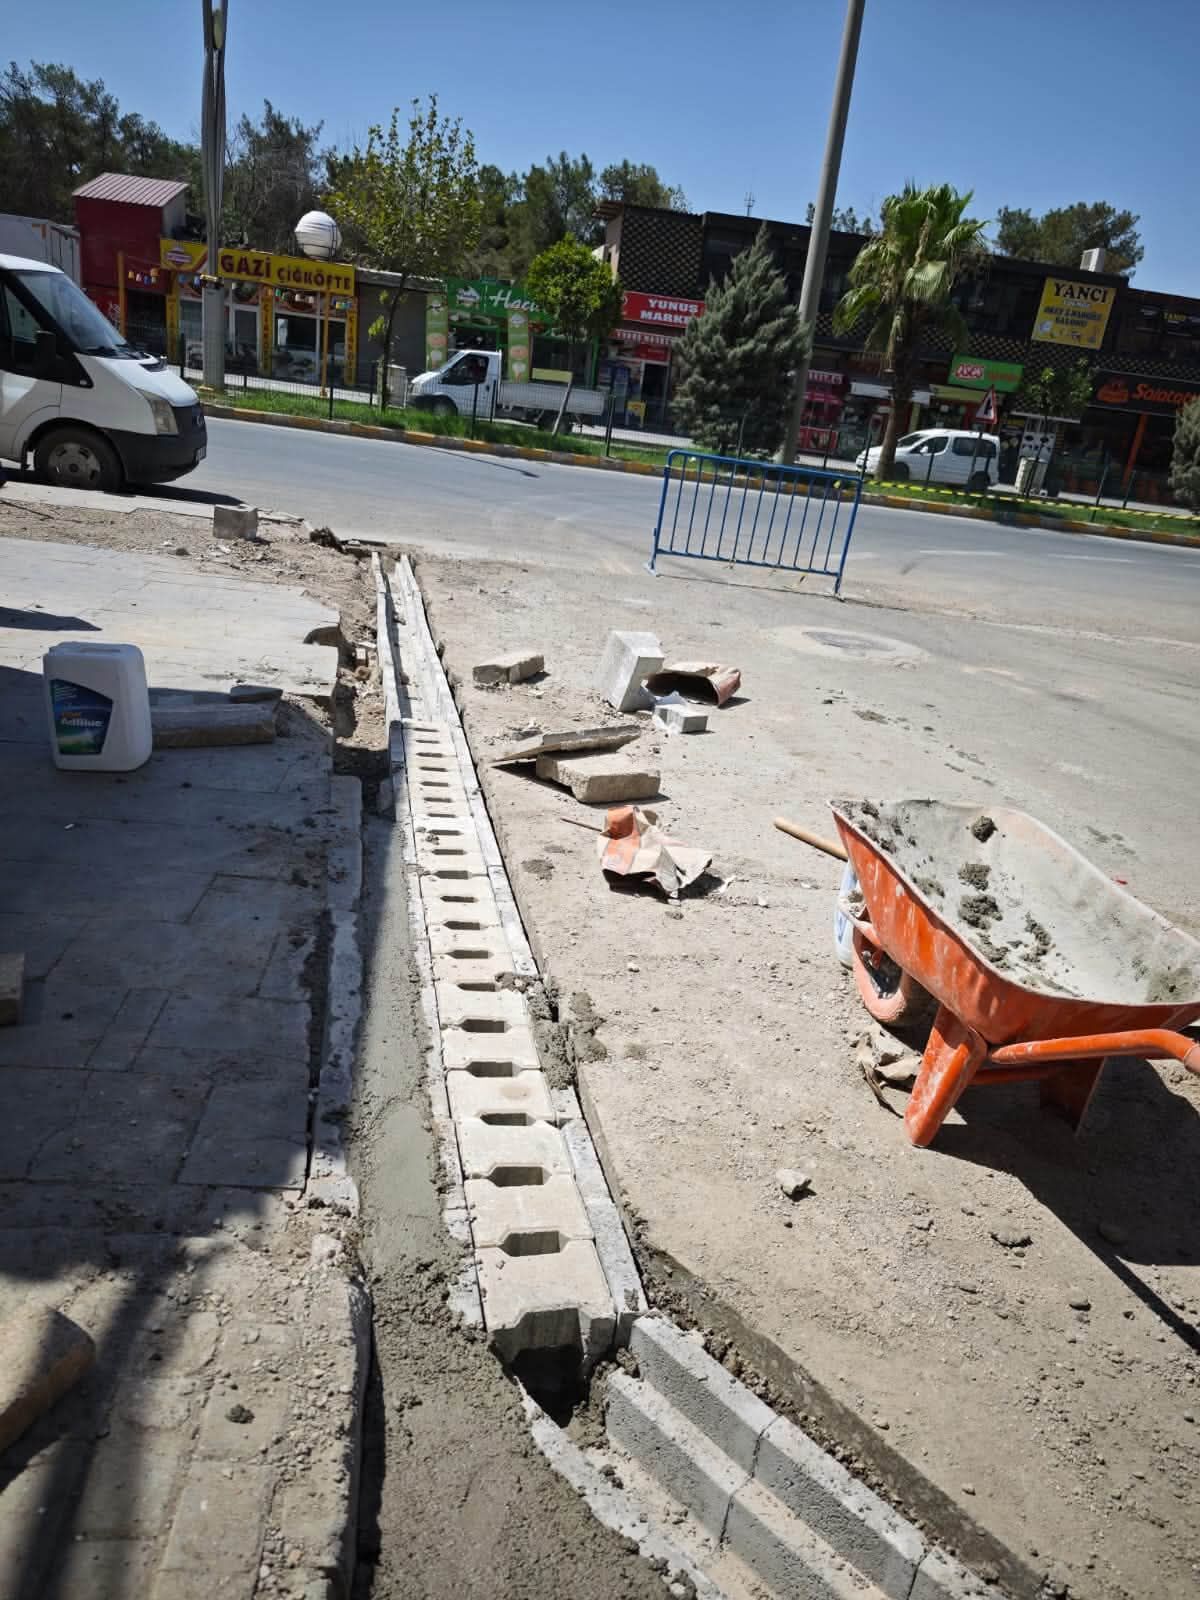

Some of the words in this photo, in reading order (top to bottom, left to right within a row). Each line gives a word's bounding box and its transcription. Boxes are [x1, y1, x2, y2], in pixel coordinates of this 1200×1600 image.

[220, 254, 271, 278] GAZİ
[648, 299, 698, 313] YUNUS
[640, 310, 689, 325] MARKE
